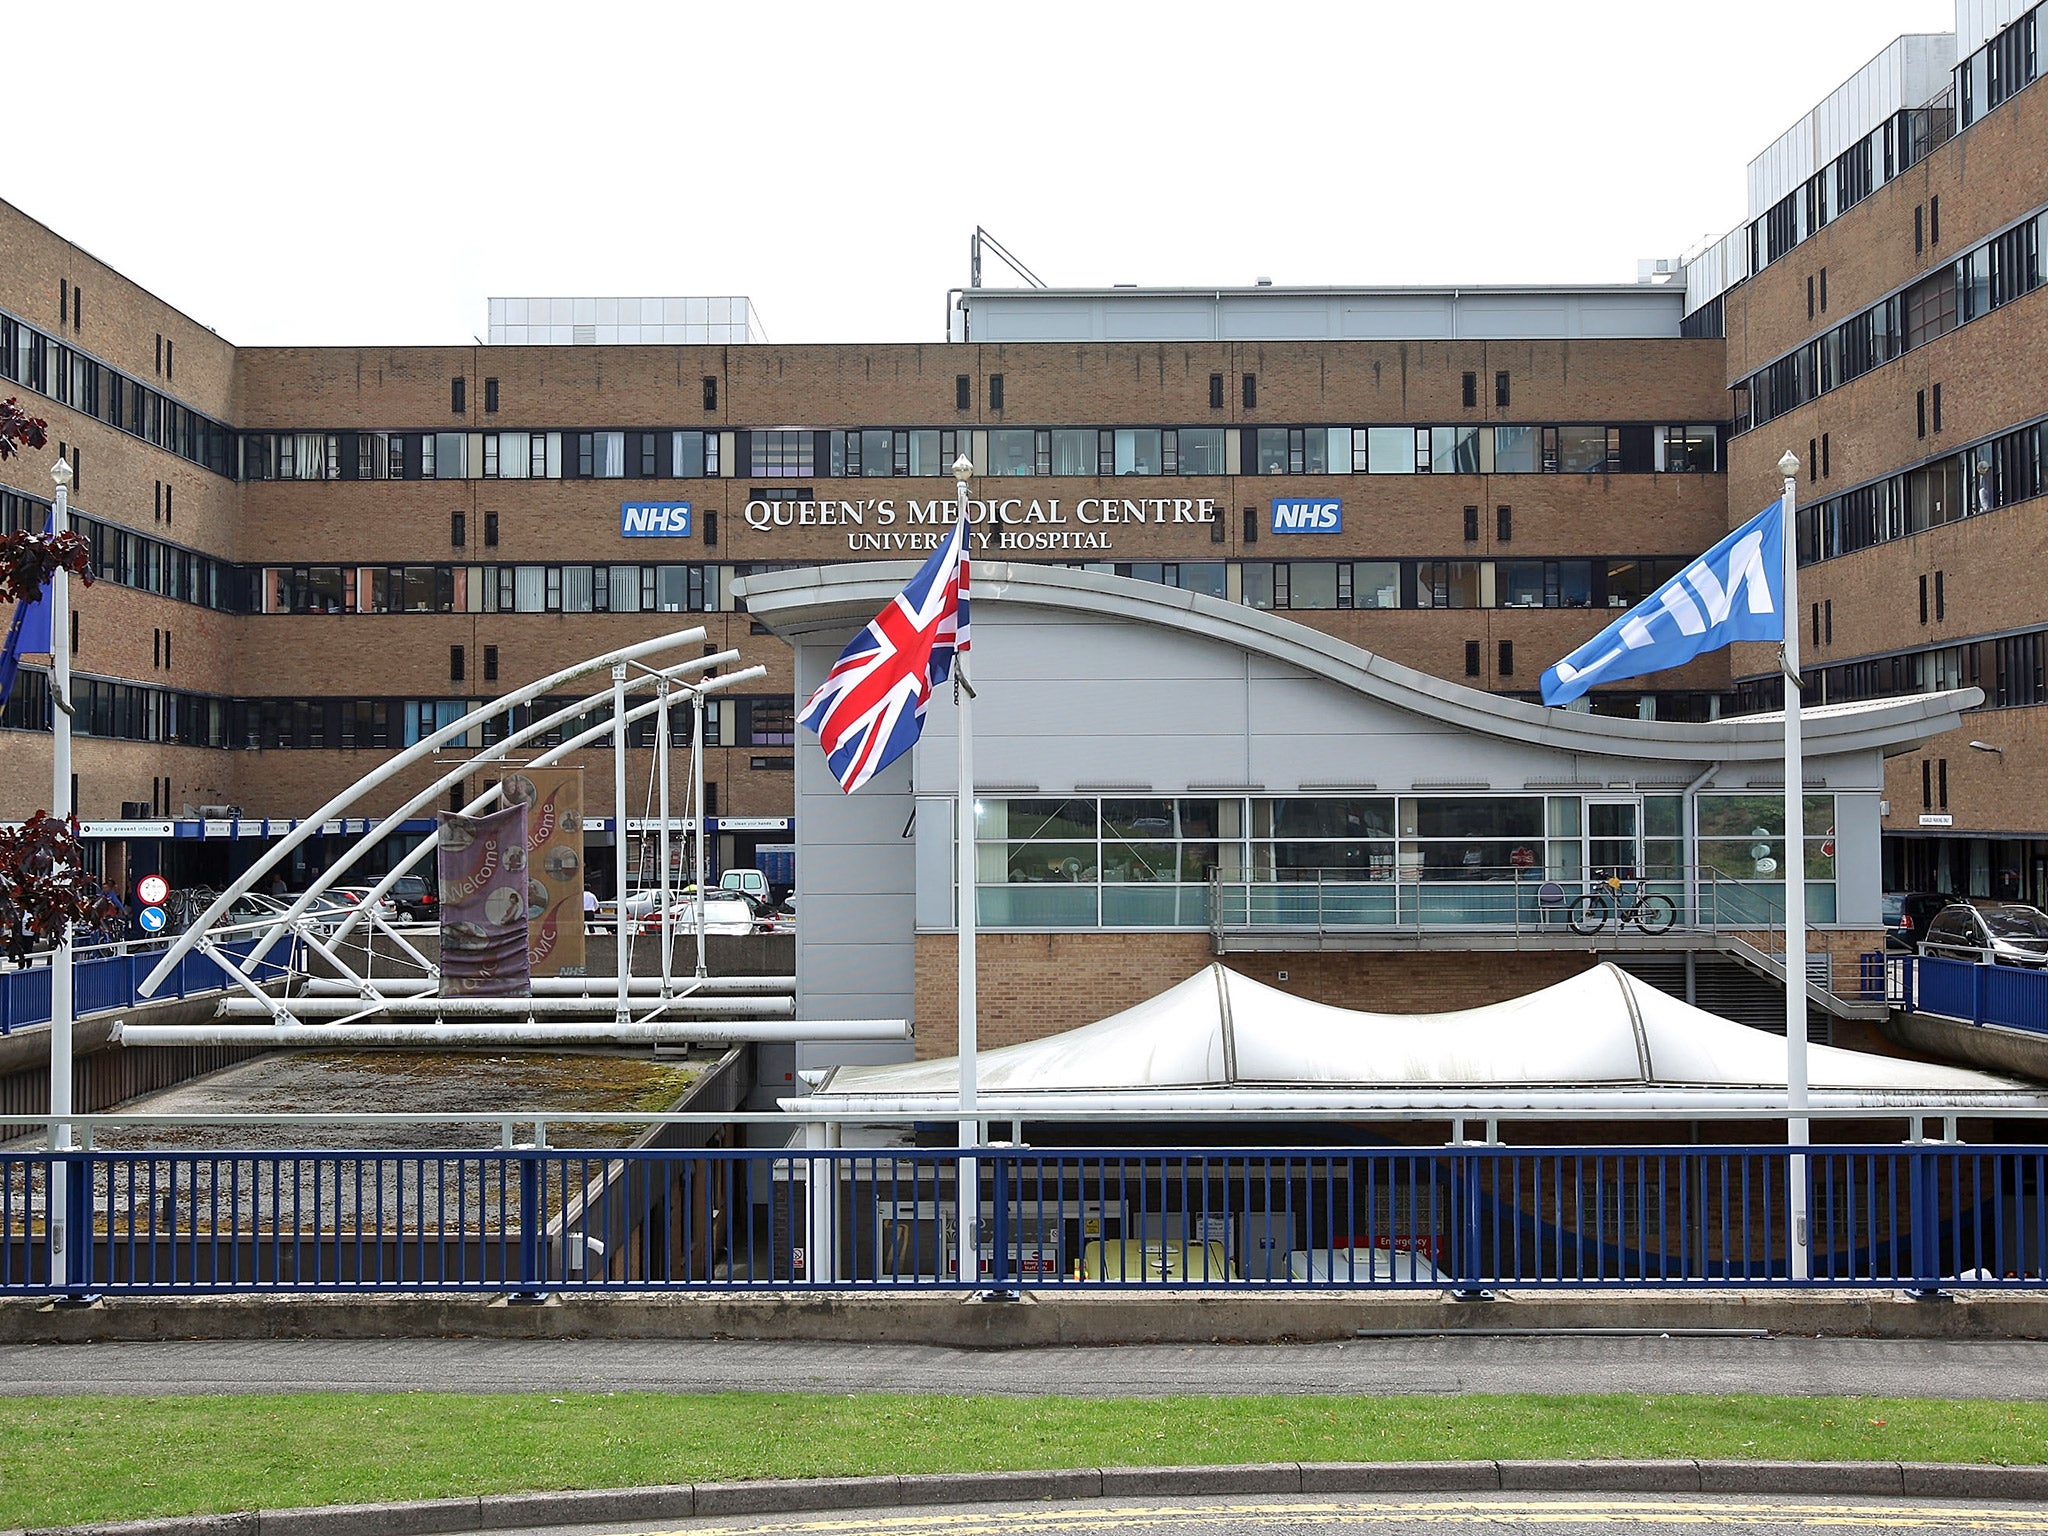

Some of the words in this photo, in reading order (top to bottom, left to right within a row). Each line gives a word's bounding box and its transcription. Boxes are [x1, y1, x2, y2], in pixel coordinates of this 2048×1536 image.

[623, 508, 688, 532] NHS
[744, 498, 896, 532] QUEEN'S
[906, 499, 1067, 525] MEDICAL
[1076, 498, 1217, 524] CENTRE
[1274, 503, 1339, 528] NHS
[1000, 532, 1113, 550] HOSPITAL
[528, 803, 555, 852] elcome
[445, 839, 499, 902] Welcome
[527, 928, 556, 965] QMC
[559, 966, 587, 976] NHS
